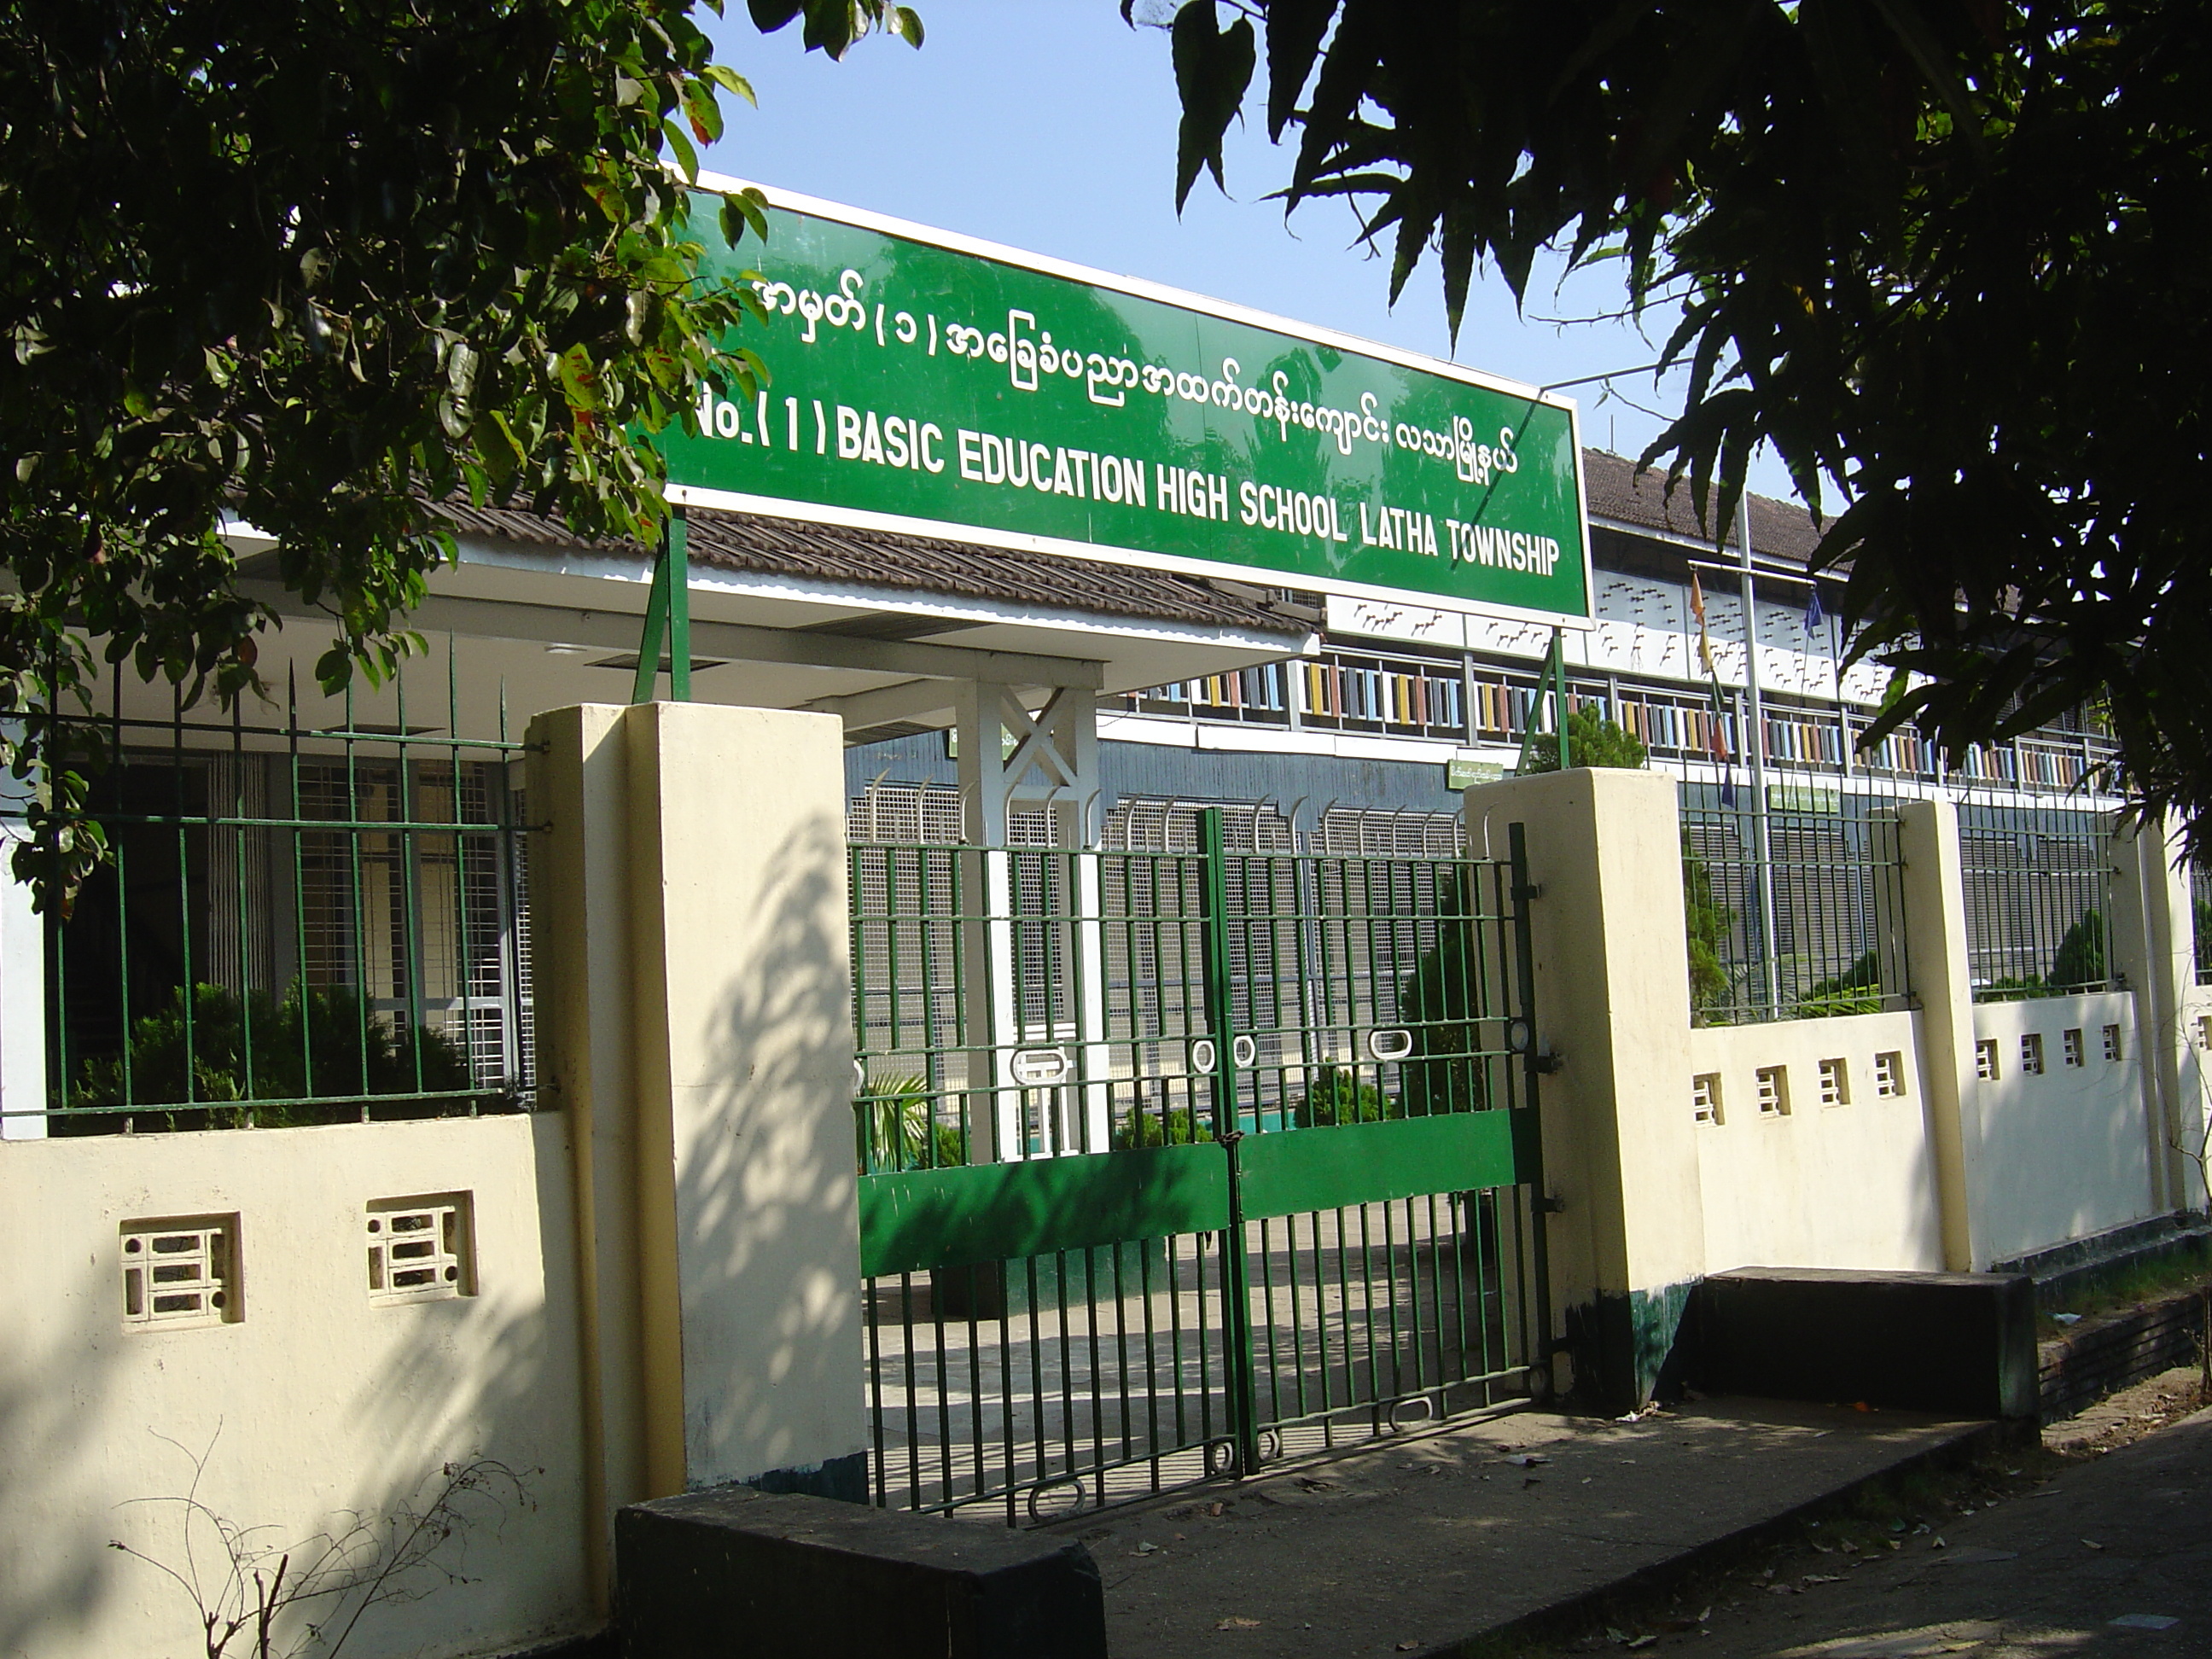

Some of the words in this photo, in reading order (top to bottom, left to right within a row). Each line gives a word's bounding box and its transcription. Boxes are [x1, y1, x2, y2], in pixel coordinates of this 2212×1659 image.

[836, 405, 945, 474] BASIC
[958, 428, 1146, 507] EDUCATION
[1156, 463, 1229, 521] HIGH
[1240, 480, 1348, 542] SCHOOL
[1359, 502, 1439, 556] LATHA
[1446, 518, 1559, 576] TOWNSHIP
